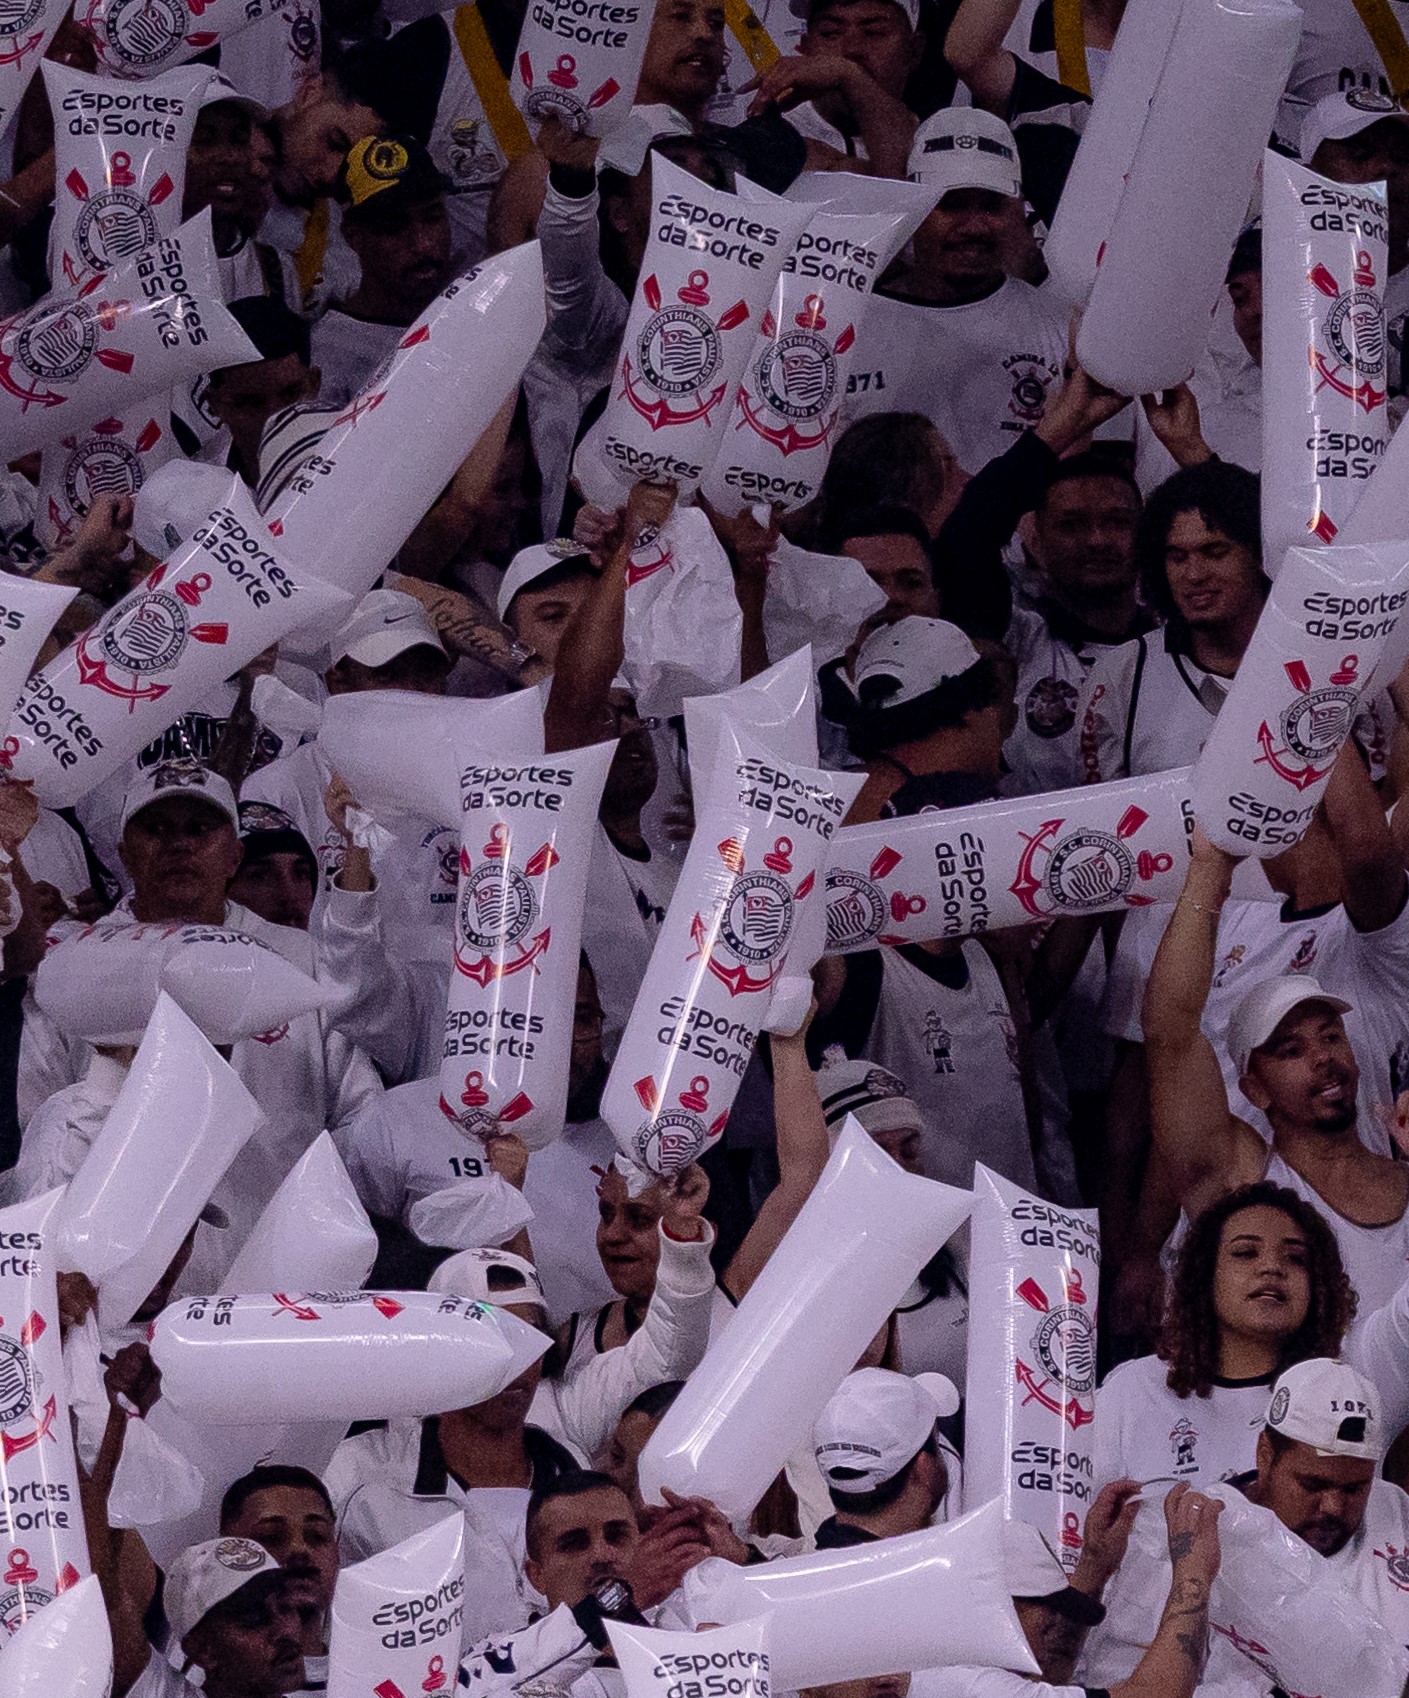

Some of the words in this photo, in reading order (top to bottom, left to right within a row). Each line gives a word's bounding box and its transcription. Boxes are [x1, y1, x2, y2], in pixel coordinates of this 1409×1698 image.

[63, 90, 183, 116] Esportes
[659, 195, 780, 246] Esportes
[208, 507, 298, 598] Esportes
[461, 766, 575, 789] Esportes
